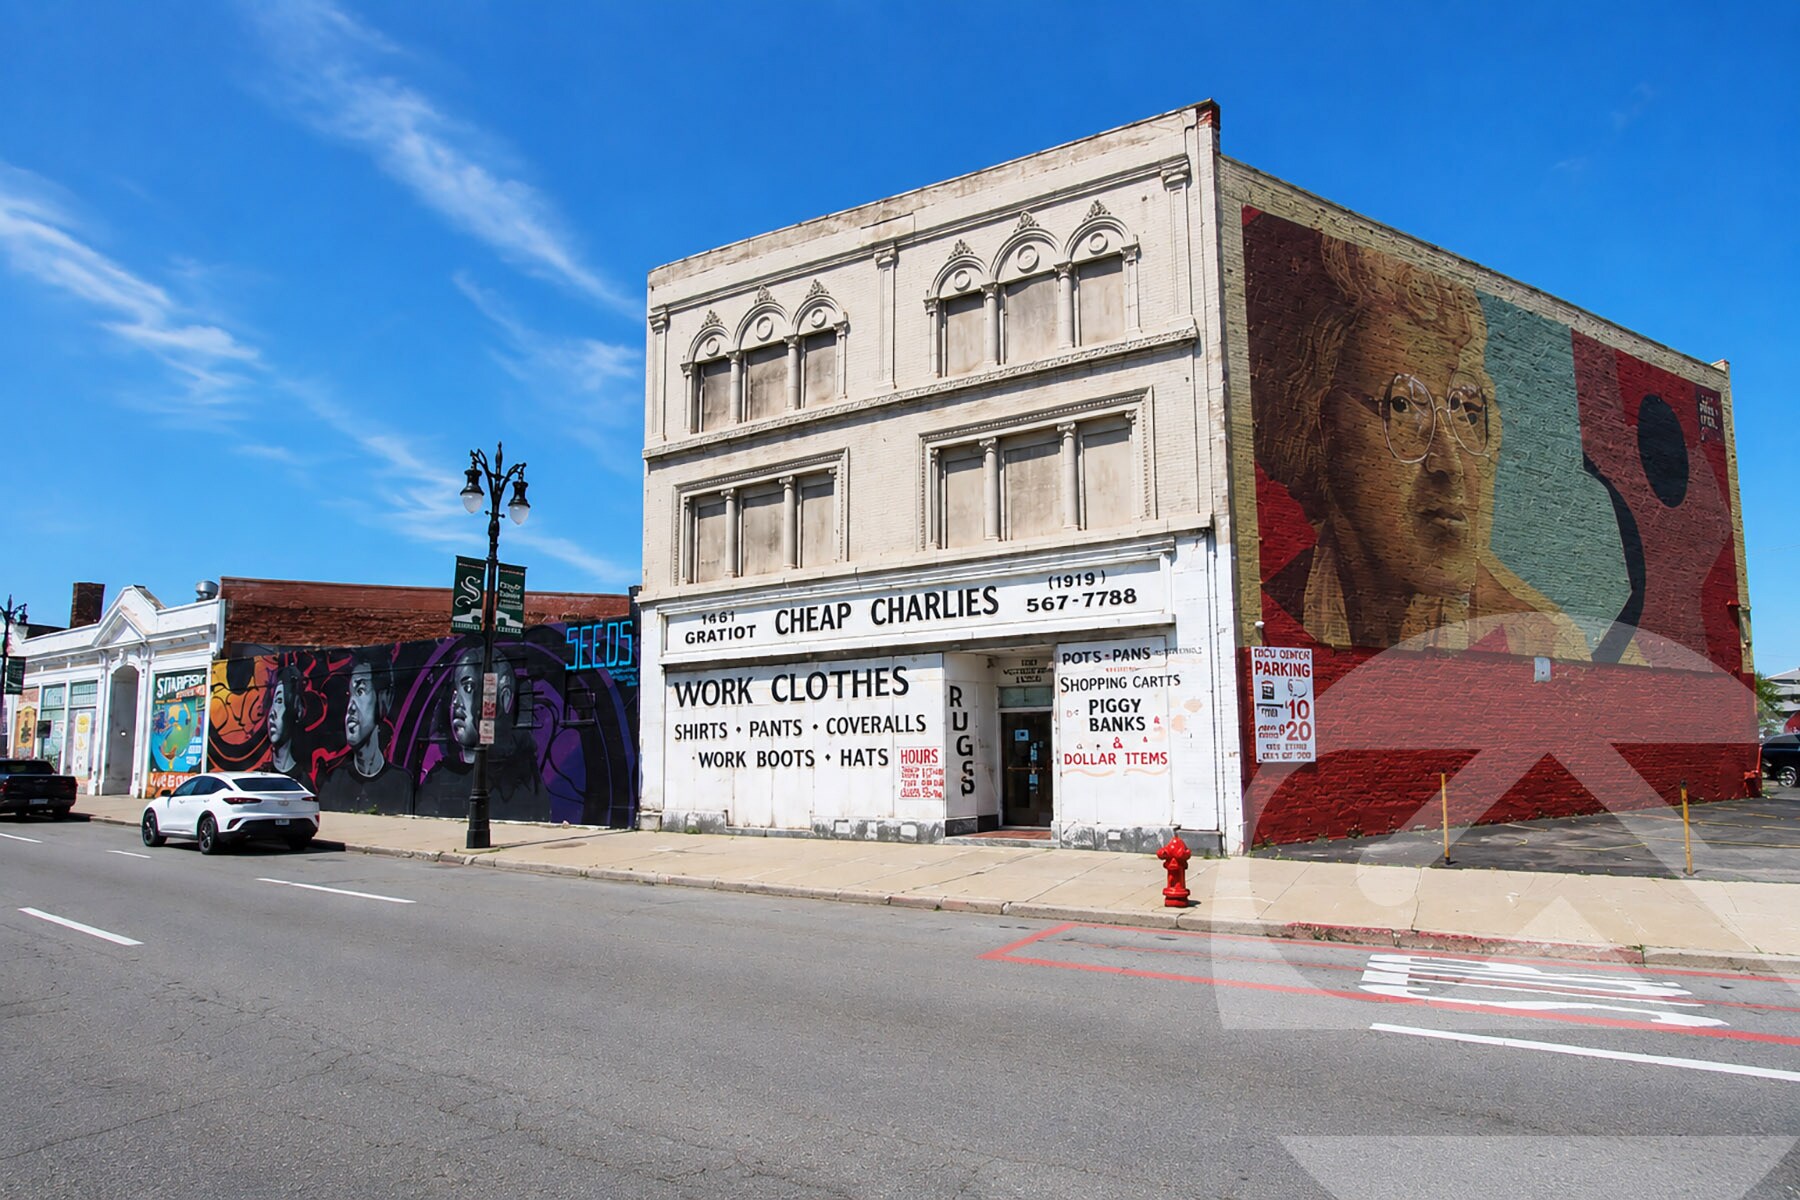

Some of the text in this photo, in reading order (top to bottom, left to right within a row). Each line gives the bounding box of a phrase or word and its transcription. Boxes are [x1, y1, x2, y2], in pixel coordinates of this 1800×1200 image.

[775, 585, 999, 635] CHEAP CHARLIES
[1026, 588, 1137, 613] 567-7788
[685, 624, 757, 645] GRATIOT
[565, 620, 633, 671] SEEDS
[1062, 651, 1102, 665] POTS
[1112, 647, 1151, 662] PANS
[1255, 660, 1311, 678] PARKING
[674, 665, 909, 708] WORK CLOTHES
[1060, 676, 1128, 694] SHOPPING
[1089, 698, 1141, 716] PIGGY
[674, 714, 927, 741] SHIRTS PANTS COVERALLS
[1089, 716, 1146, 733] BANKS
[699, 748, 889, 769] WORK BOOTS HATS
[901, 748, 938, 764] HOURS
[1064, 753, 1117, 766] DOLLAR
